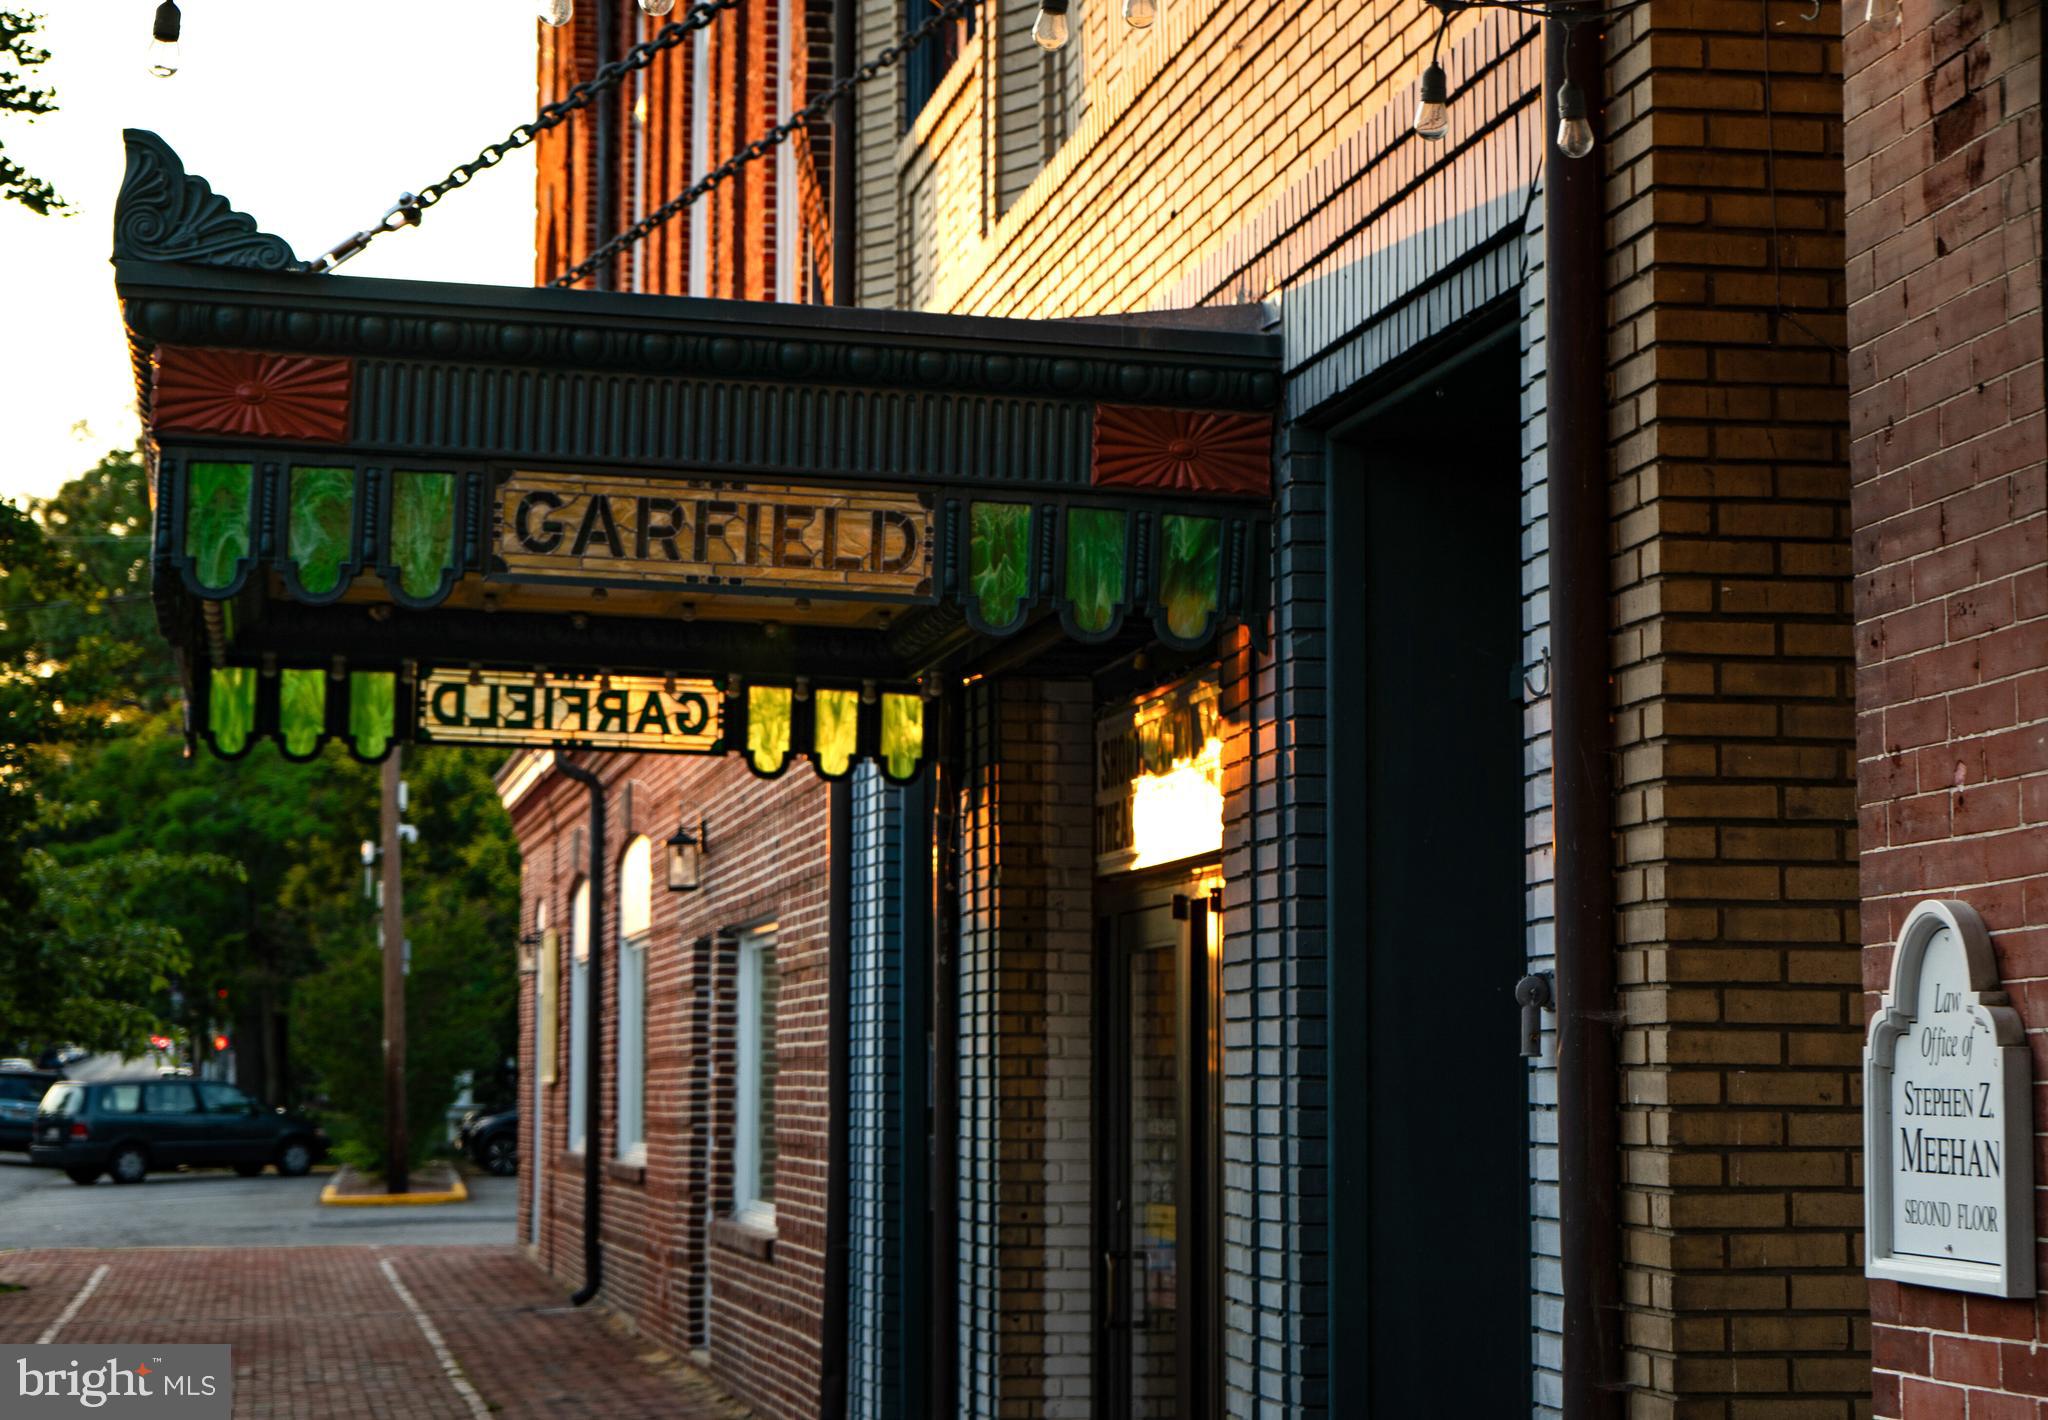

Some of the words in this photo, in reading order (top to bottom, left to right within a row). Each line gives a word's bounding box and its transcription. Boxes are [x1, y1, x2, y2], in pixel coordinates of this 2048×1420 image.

[515, 491, 917, 573] GARFIELD
[1934, 983, 1962, 1013] Law
[1921, 1026, 1959, 1066] Office
[1962, 1025, 1976, 1066] of
[1904, 1080, 1974, 1118] STEPHEN
[1978, 1082, 1995, 1119] Z.
[1900, 1127, 2001, 1179] MEEHAN
[1904, 1199, 1952, 1229] SECOND
[1957, 1203, 1999, 1233] FLOOR
